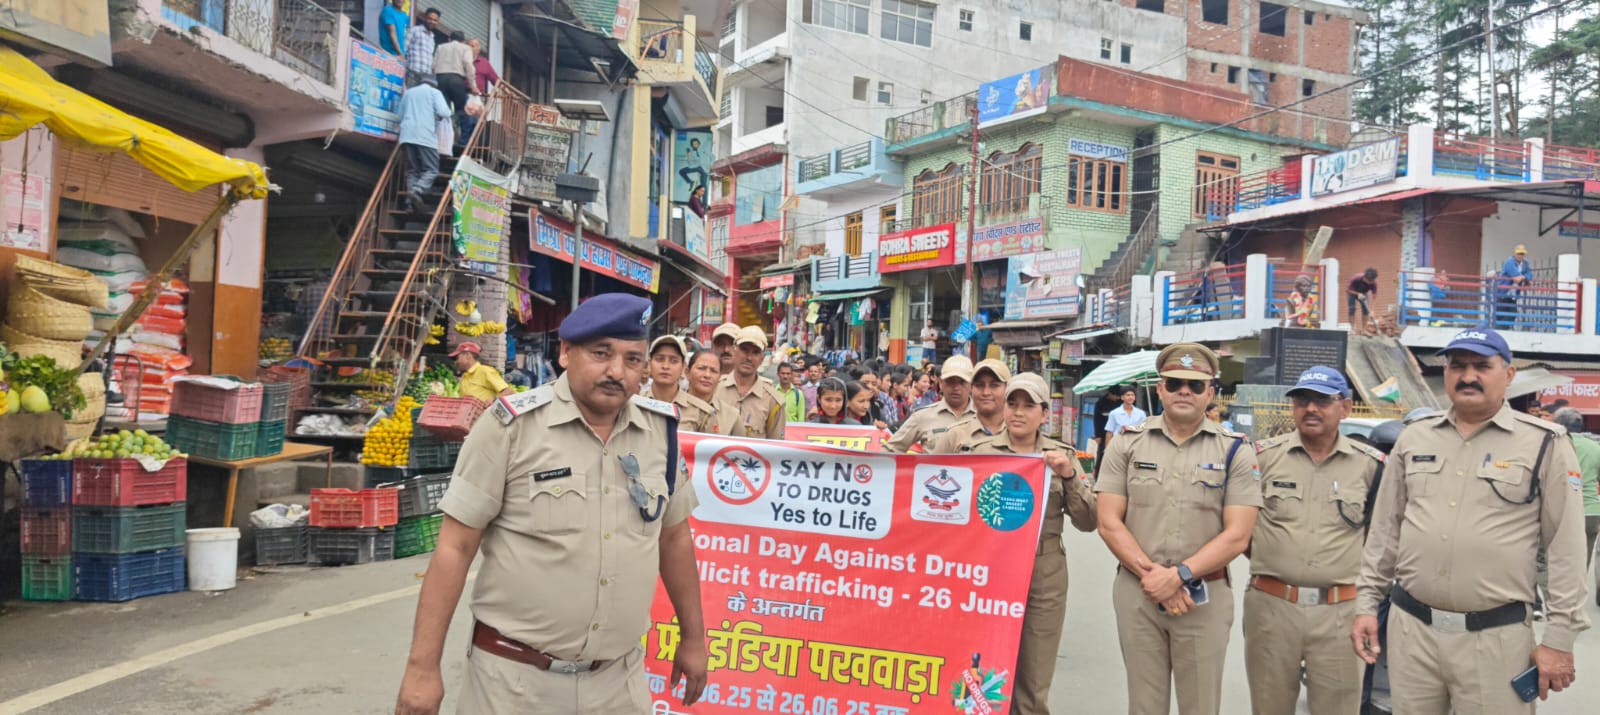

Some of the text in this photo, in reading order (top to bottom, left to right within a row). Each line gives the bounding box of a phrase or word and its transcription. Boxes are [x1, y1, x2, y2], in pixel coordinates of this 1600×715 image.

[1070, 140, 1127, 159] RECEPTION
[880, 230, 950, 257] BOHRA SWEETS
[780, 460, 826, 480] SAY
[777, 482, 872, 507] TO DRUGS
[770, 502, 877, 532] Yes to Life
[758, 535, 807, 565] Day
[814, 542, 917, 574] Against
[924, 554, 989, 587] Drug
[727, 591, 826, 622] के अन्तर्गत
[758, 567, 894, 608] trafficking
[918, 585, 952, 609] 26
[959, 592, 1025, 619] June
[706, 619, 804, 678] इंडिया
[807, 640, 946, 704] पखवाड़ा
[756, 683, 778, 711] से
[969, 682, 992, 714] DRUGS
